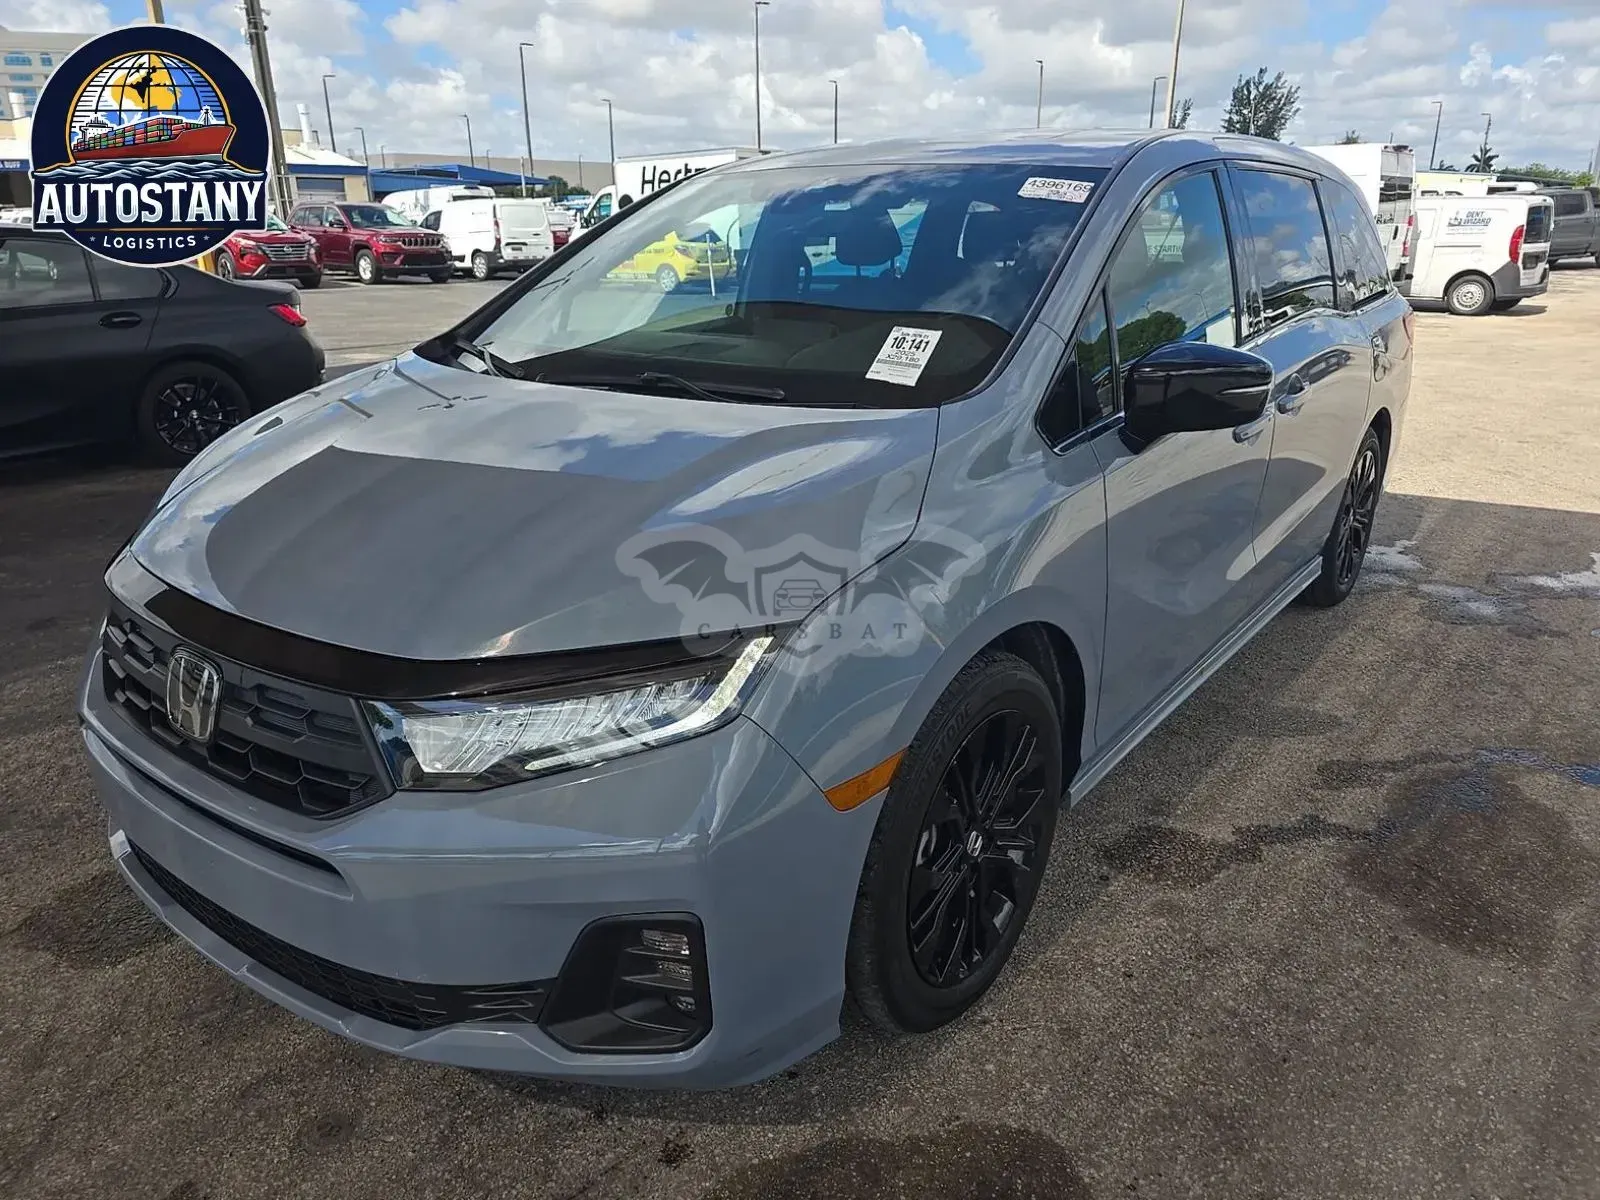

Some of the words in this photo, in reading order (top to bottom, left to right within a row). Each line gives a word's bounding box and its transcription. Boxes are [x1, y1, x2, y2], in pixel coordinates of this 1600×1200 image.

[641, 163, 706, 194] Hert
[1028, 179, 1092, 192] 4396169
[1466, 210, 1486, 218] DENT
[890, 336, 930, 352] 10:141
